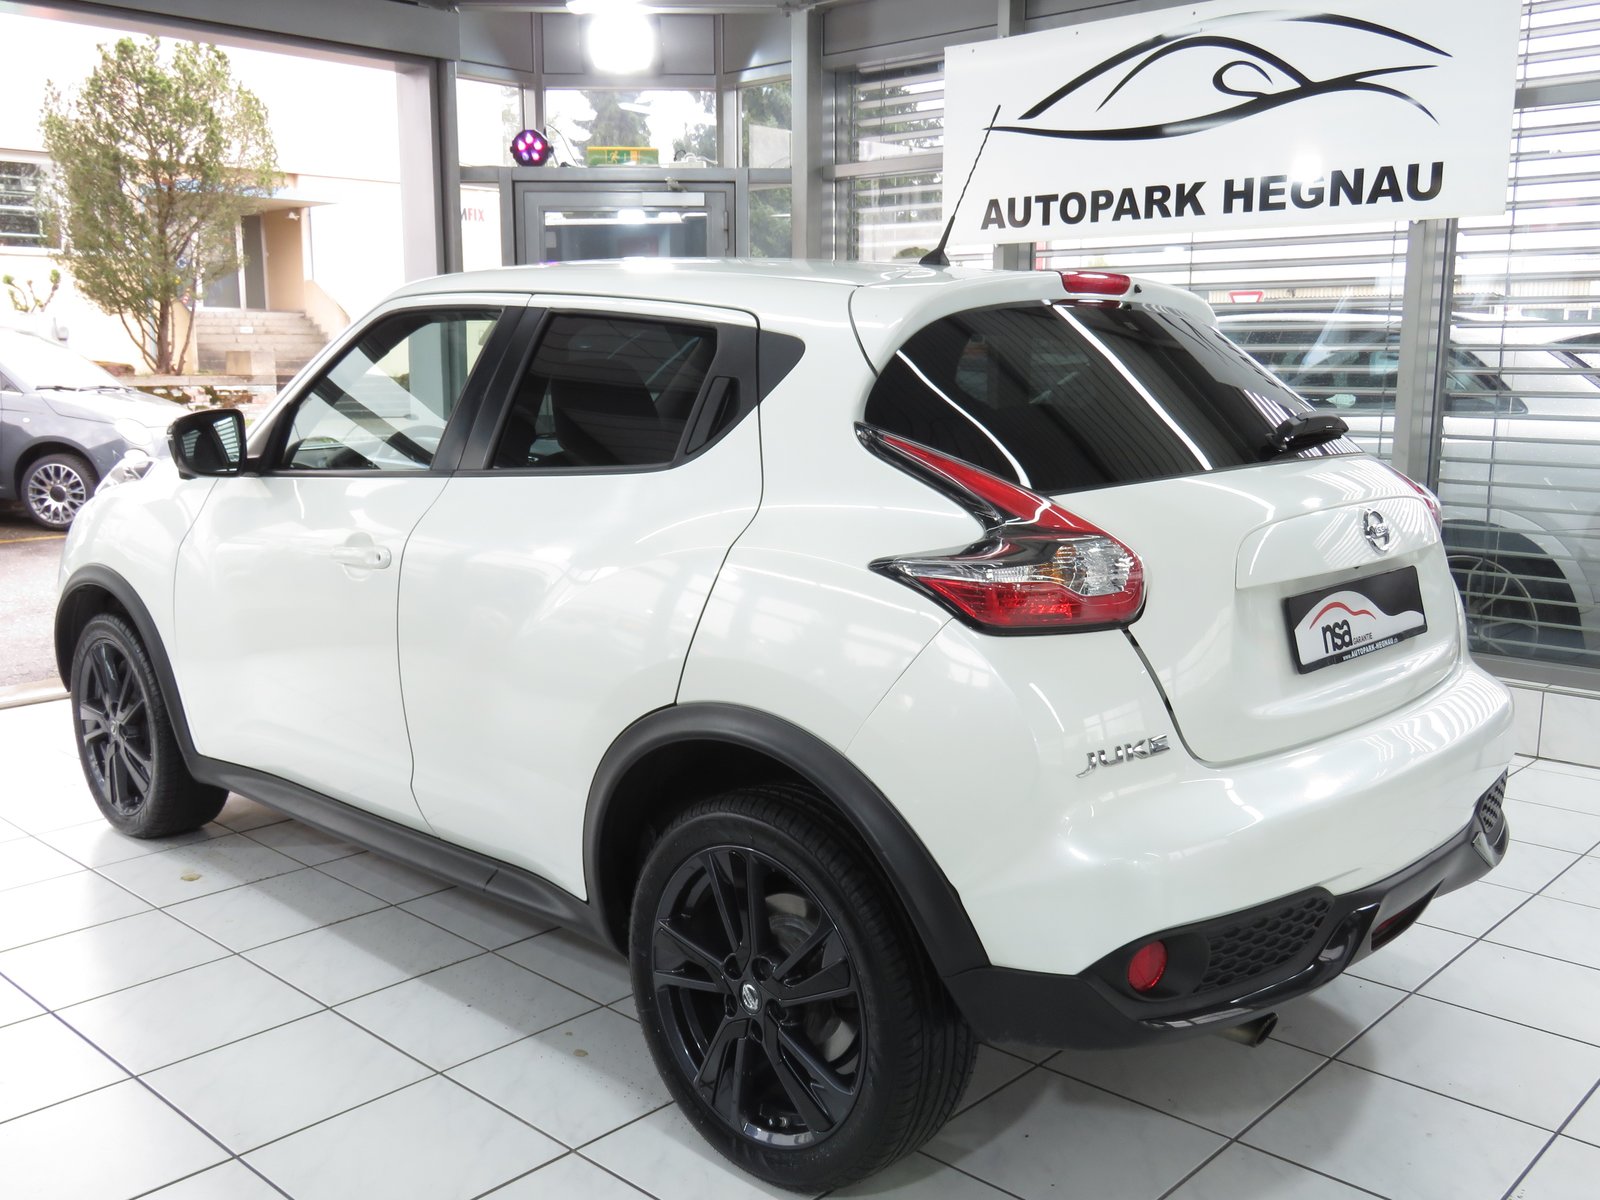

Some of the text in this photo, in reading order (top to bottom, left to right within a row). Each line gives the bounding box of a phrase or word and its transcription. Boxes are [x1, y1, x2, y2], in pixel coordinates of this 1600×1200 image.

[980, 161, 1444, 231] AUTOPARK HEGNAU
[1321, 619, 1353, 654] nsa
[1353, 632, 1373, 645] GARANTIE
[1076, 734, 1170, 778] JUKE
